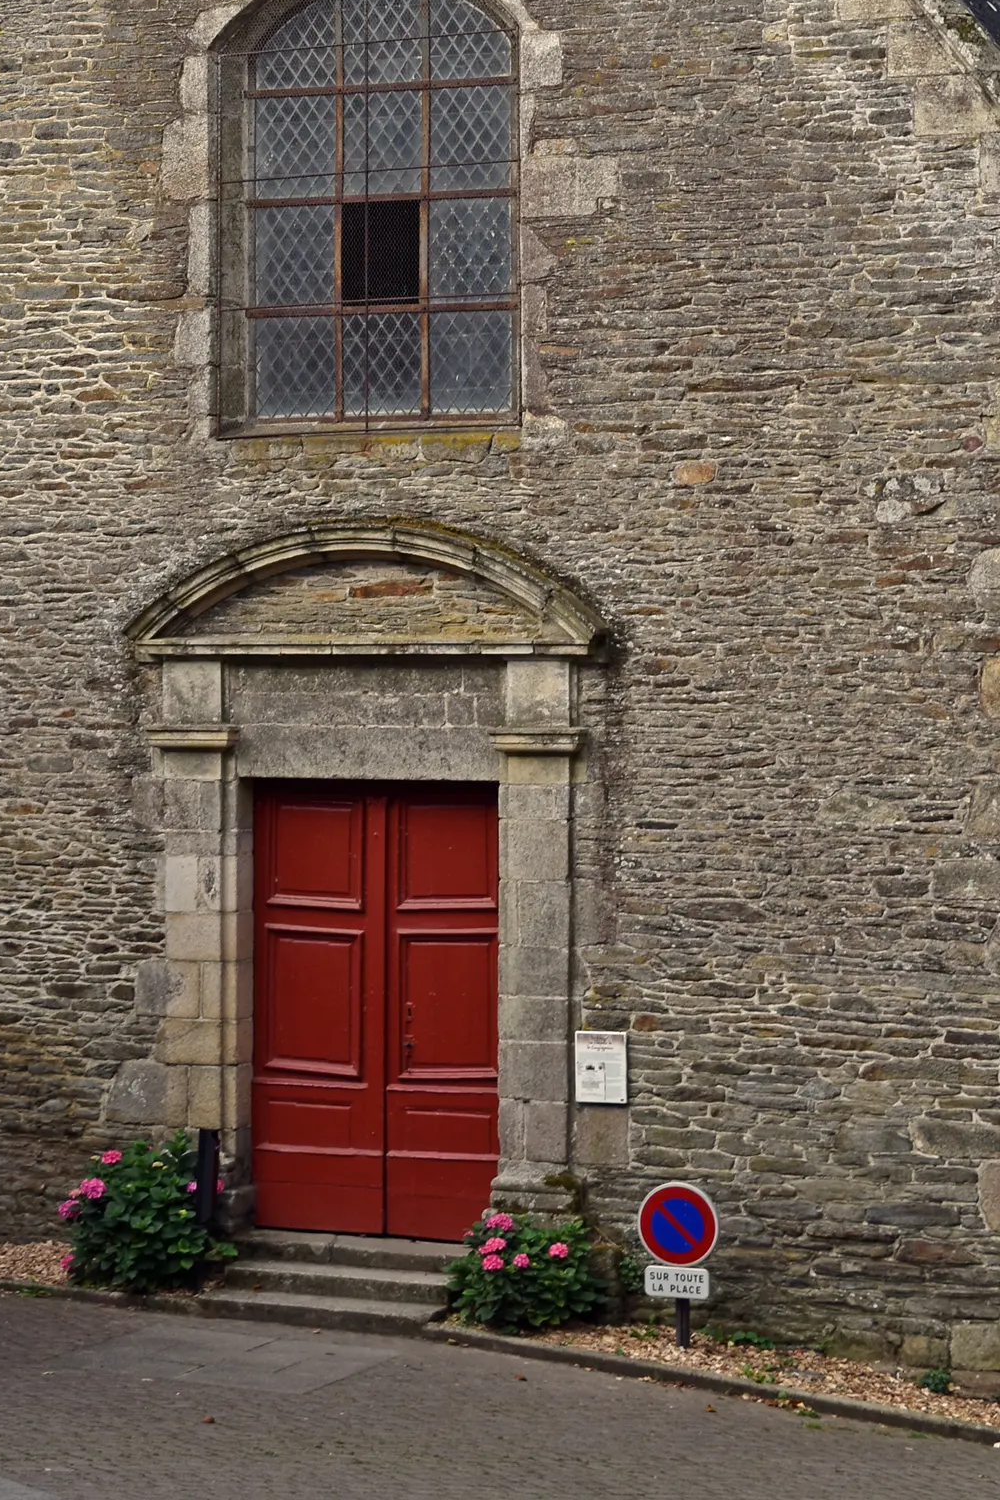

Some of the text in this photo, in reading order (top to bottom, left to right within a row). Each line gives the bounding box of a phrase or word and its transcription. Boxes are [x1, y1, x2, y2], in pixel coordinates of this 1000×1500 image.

[649, 1271, 704, 1283] SUR TOUTE
[652, 1283, 701, 1294] LA PLACE
